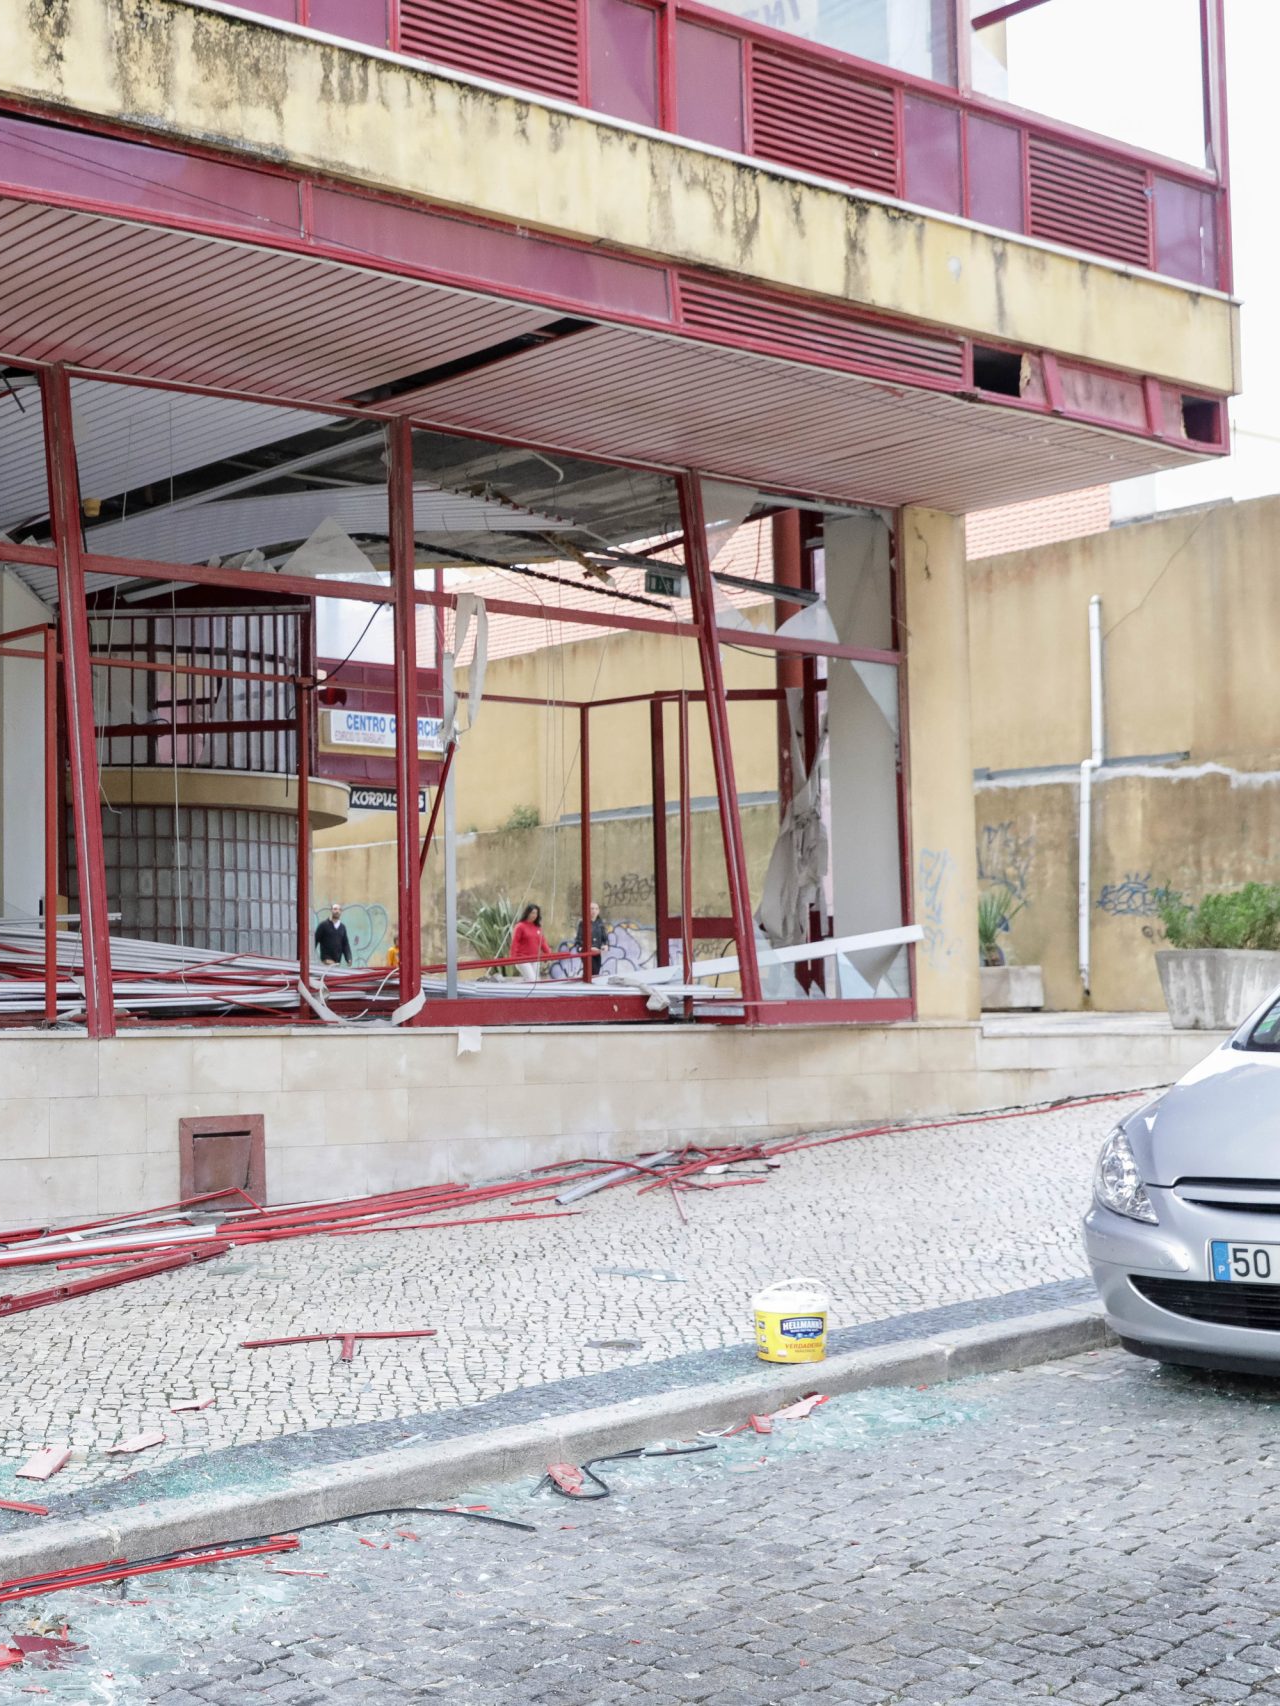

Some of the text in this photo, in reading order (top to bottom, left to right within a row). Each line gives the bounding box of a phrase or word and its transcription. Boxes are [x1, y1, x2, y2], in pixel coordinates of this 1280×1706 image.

[346, 714, 386, 733] CENTRO
[1218, 1248, 1271, 1279] P 50
